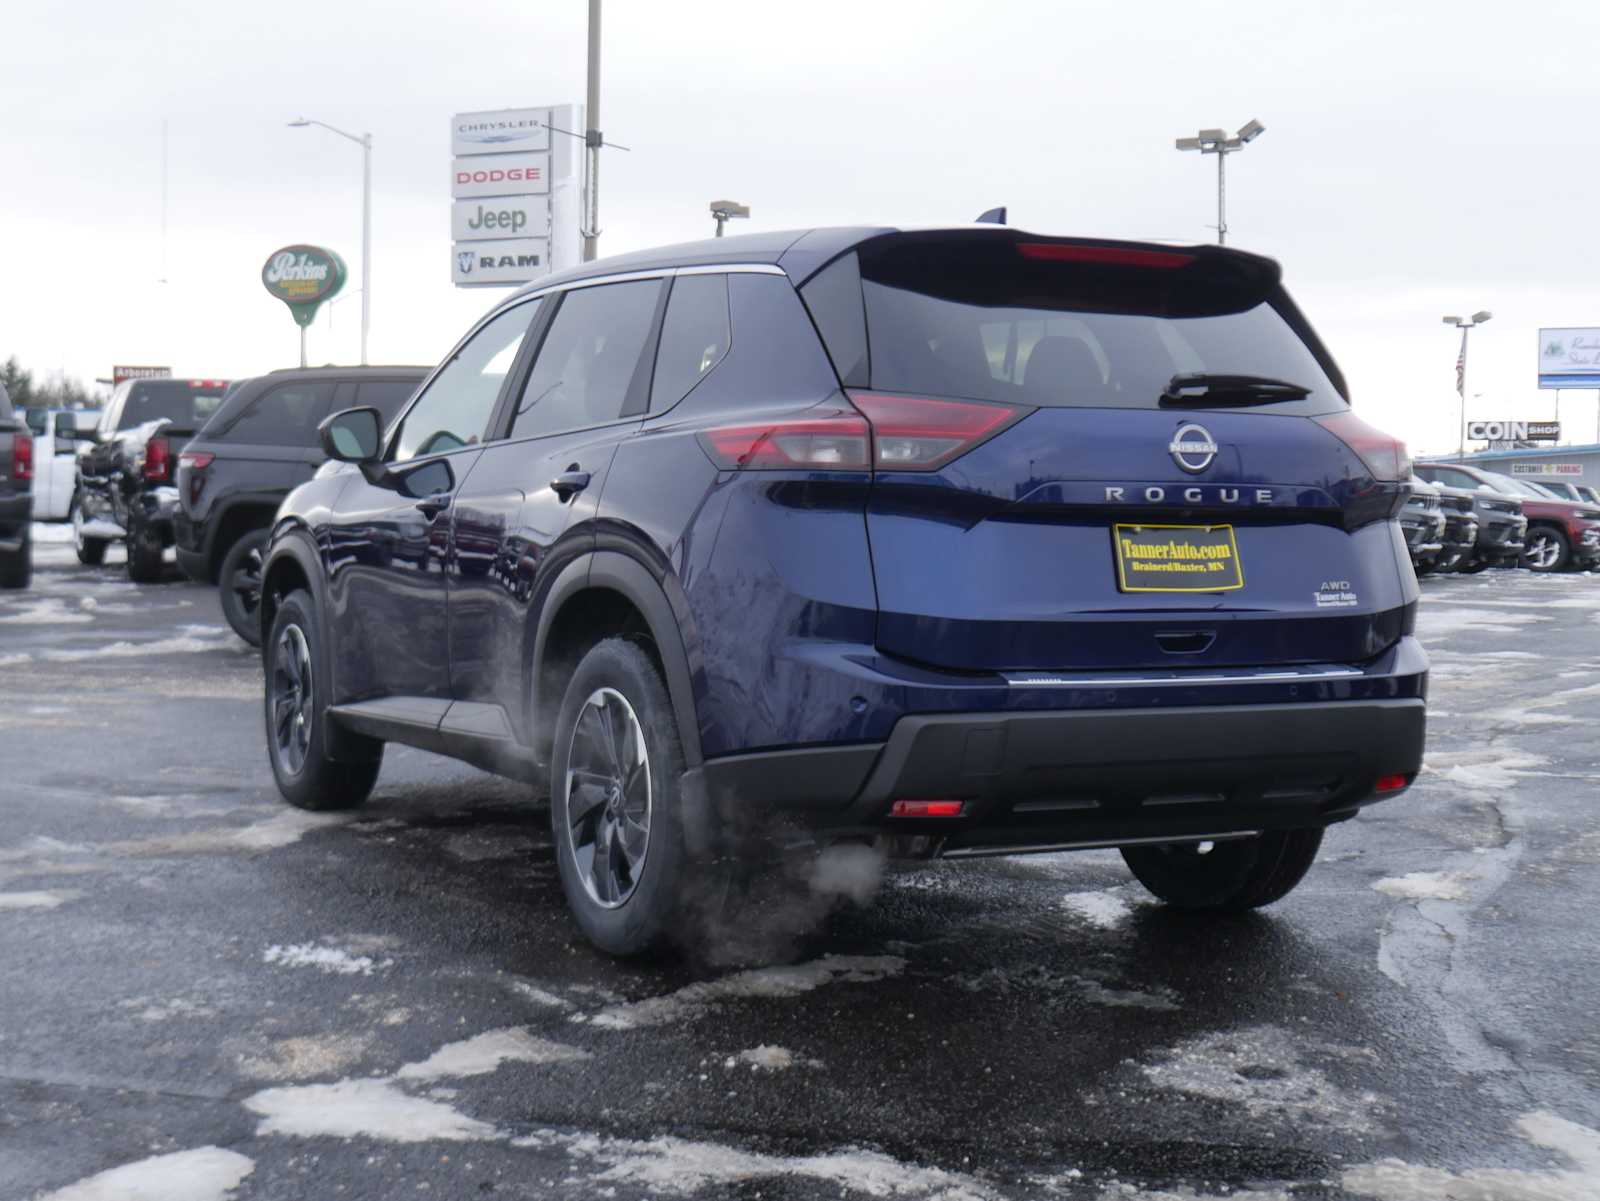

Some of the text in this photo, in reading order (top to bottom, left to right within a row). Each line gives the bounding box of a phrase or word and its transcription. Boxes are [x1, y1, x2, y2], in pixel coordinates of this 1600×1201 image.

[458, 119, 540, 133] CHRYSLER
[456, 168, 541, 185] DODGE
[468, 205, 527, 233] Jeep
[479, 255, 540, 269] RAM
[1470, 421, 1560, 441] COIN SHOP
[1105, 486, 1273, 503] ROGUE
[1122, 539, 1231, 560] TannerAuto.com
[1320, 580, 1350, 592] AWD
